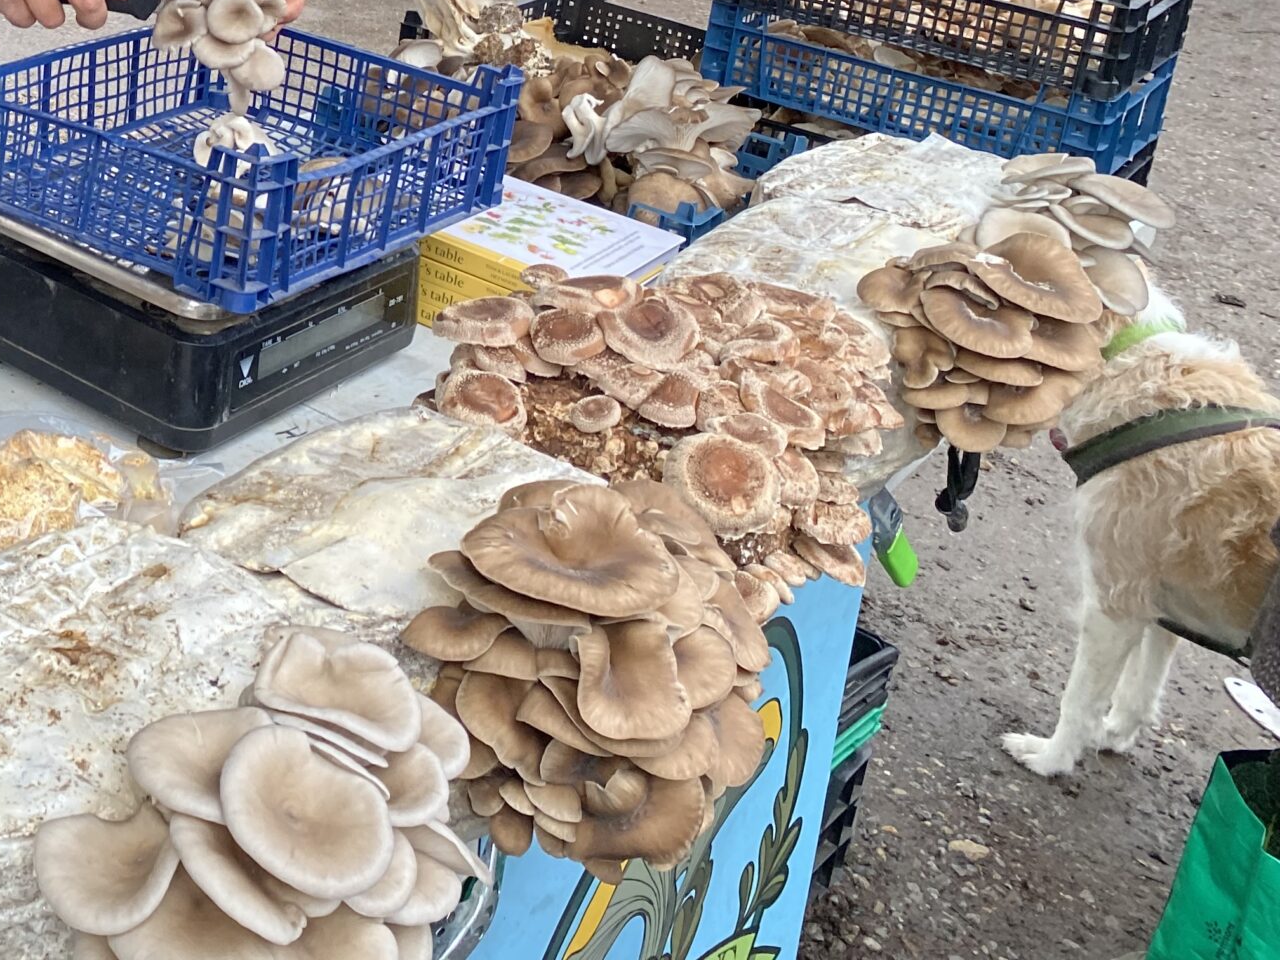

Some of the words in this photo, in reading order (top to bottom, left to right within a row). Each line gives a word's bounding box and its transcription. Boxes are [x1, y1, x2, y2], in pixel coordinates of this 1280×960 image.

[435, 245, 464, 265] table
[435, 268, 464, 289] table
[430, 288, 458, 307] tabl
